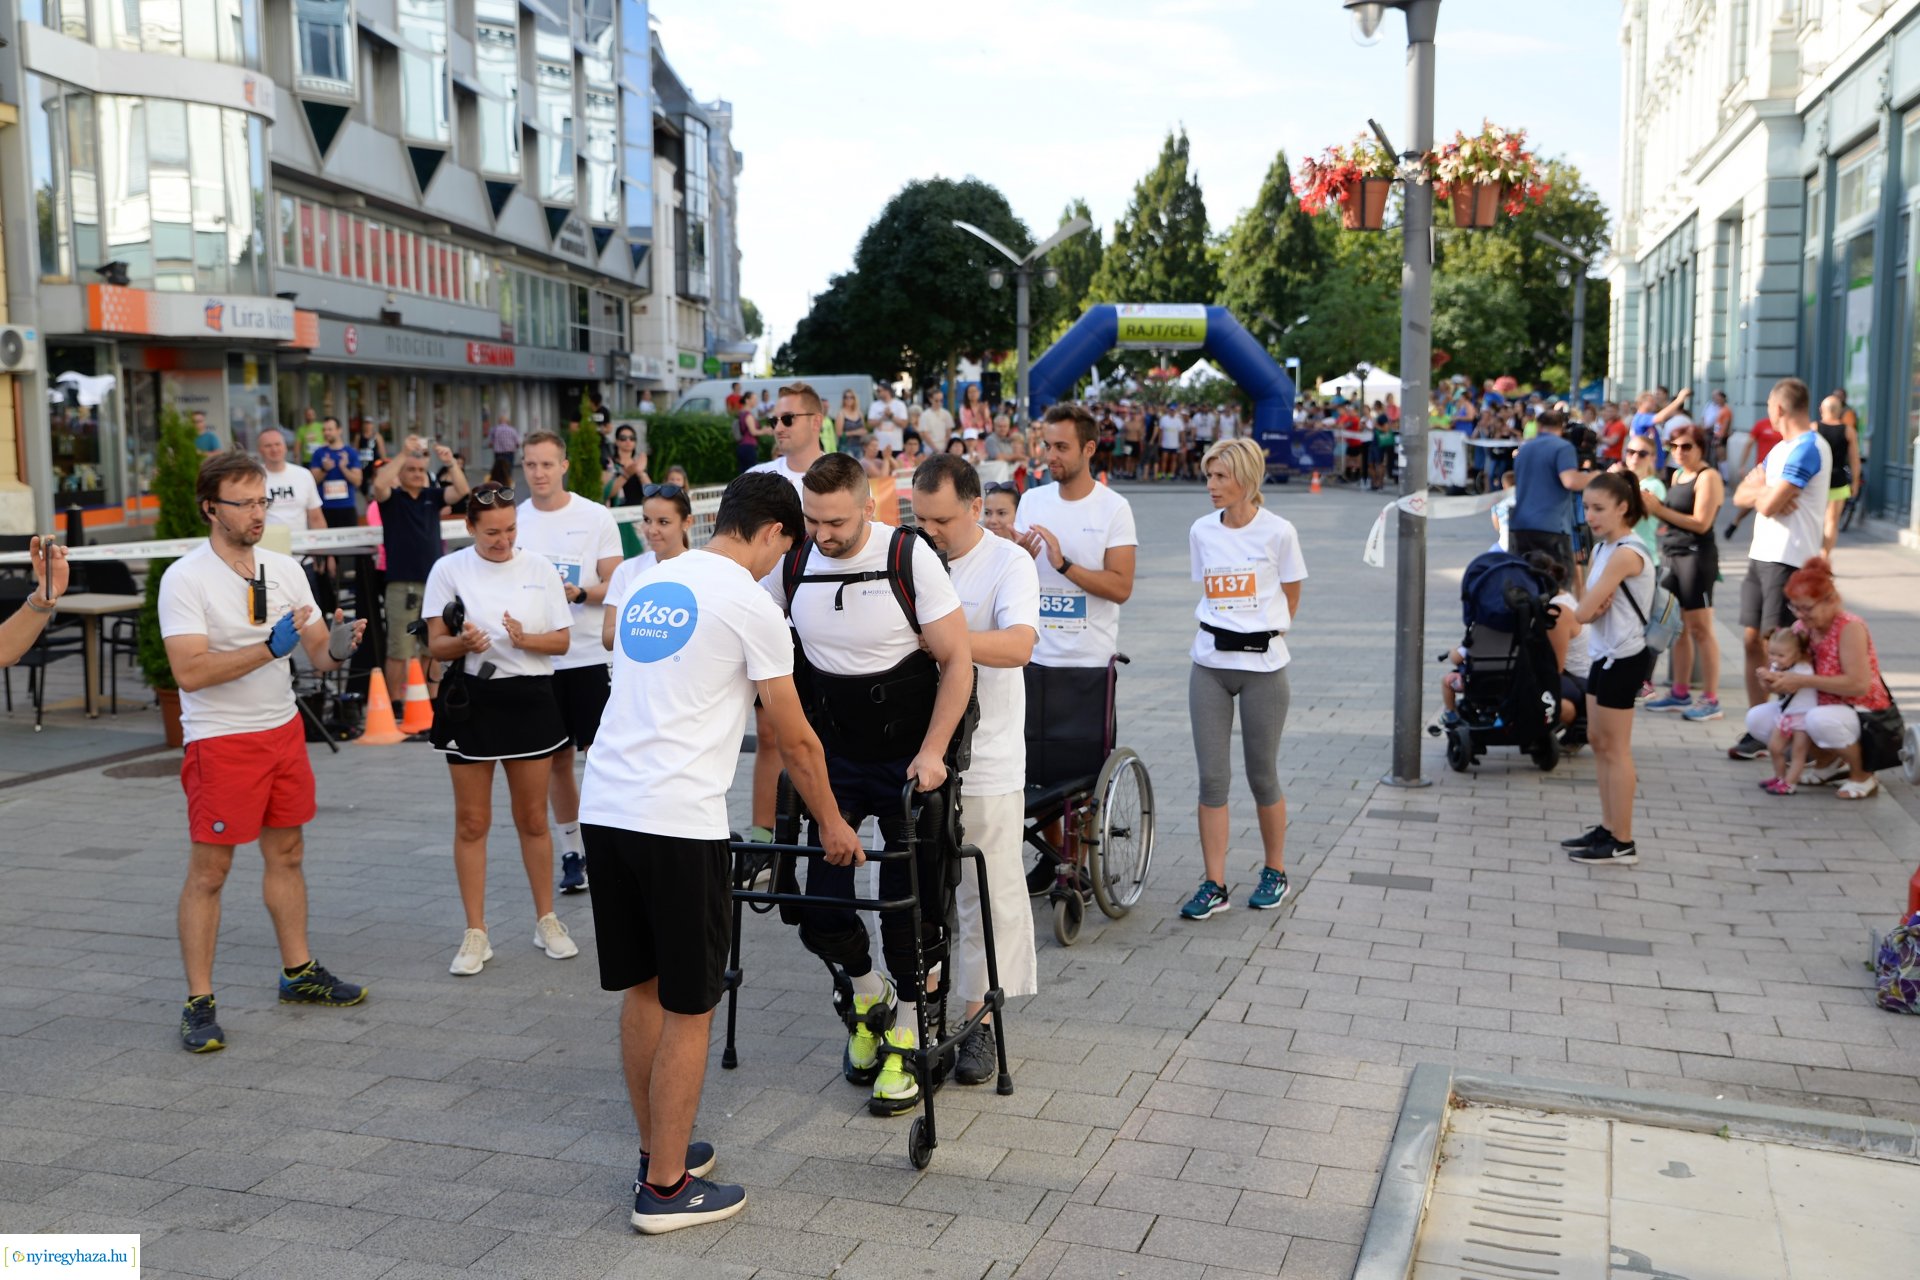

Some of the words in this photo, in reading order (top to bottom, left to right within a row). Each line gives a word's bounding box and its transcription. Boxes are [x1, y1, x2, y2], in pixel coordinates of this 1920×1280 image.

[1126, 322, 1196, 338] RAJT/CÉL
[557, 565, 569, 580] 5
[1206, 575, 1249, 593] 1137
[1039, 596, 1075, 613] 652
[626, 600, 690, 628] ekso
[631, 627, 669, 639] BIONICS
